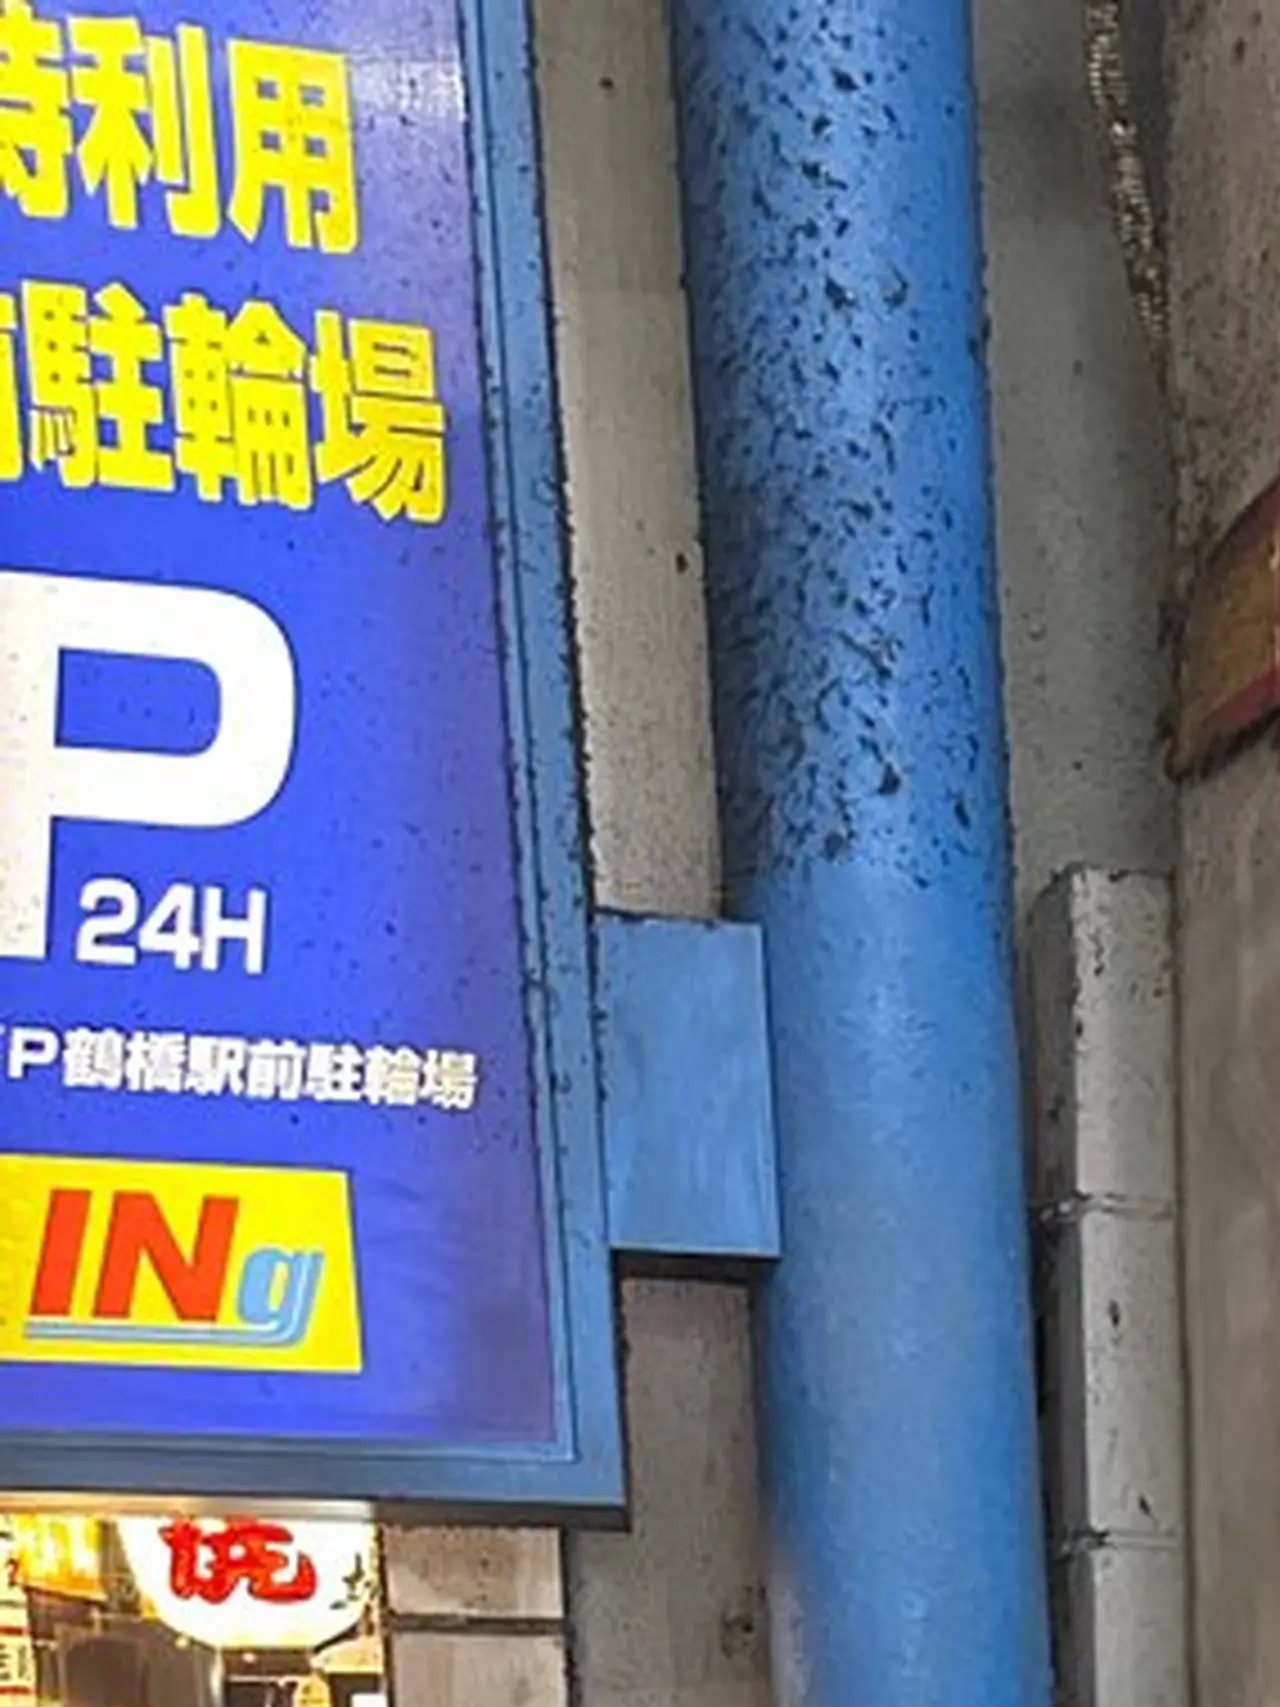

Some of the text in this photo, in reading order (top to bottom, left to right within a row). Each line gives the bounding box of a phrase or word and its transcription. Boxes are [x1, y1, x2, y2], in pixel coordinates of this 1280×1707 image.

[0, 280, 446, 523] 駐輪場
[0, 569, 296, 959] P
[75, 876, 268, 974] 24H
[0, 1025, 478, 1110] P鶴橋駅前駐輪場
